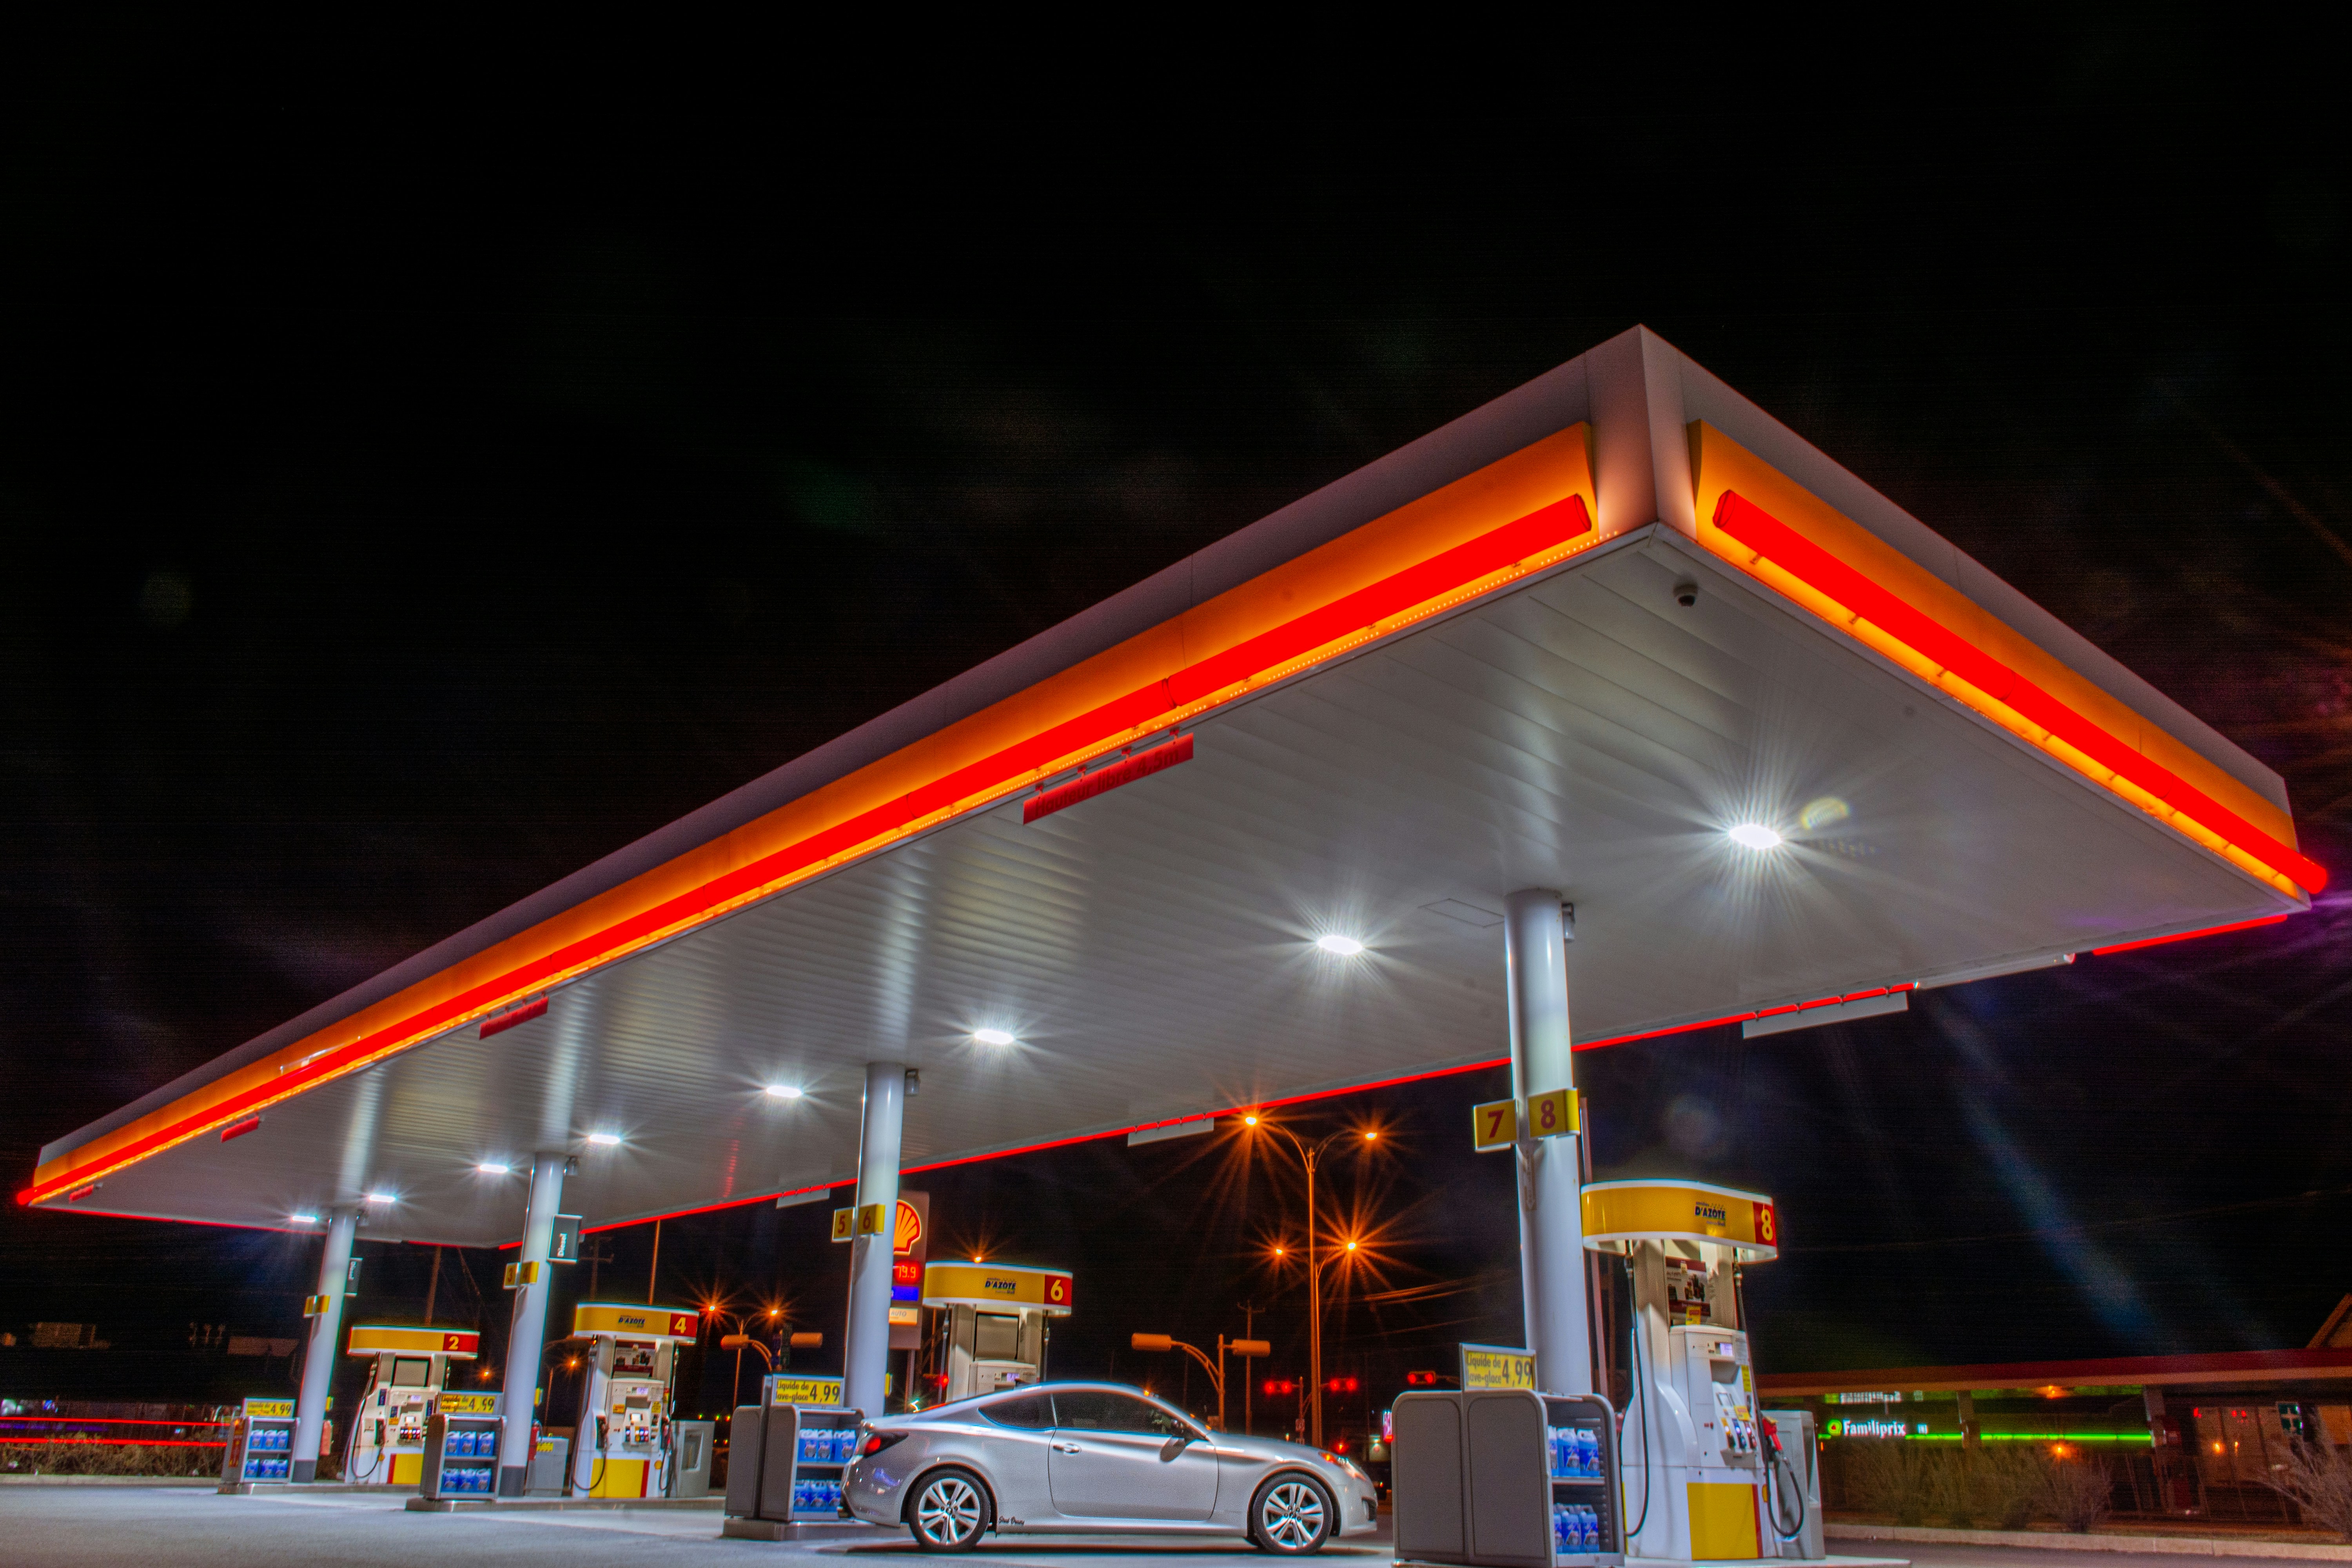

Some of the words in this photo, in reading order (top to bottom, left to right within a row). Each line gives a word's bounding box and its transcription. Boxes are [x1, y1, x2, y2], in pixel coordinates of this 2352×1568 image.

[1488, 1109, 1504, 1138] 7
[1541, 1099, 1556, 1129] 8
[838, 1214, 846, 1234] 5
[863, 1210, 871, 1230] 6
[1761, 1209, 1773, 1241] 8
[557, 1233, 568, 1257] Diesel
[1051, 1279, 1063, 1301] 6
[674, 1317, 686, 1334] 4
[448, 1336, 459, 1350] 2
[1493, 1354, 1501, 1368] de
[1468, 1370, 1501, 1387] ave-glace
[1502, 1359, 1532, 1387] 4,99
[801, 1380, 809, 1390] de
[810, 1384, 840, 1403] 4,99
[270, 1403, 292, 1416] 4,99
[1842, 1418, 1906, 1439] Familiprix
